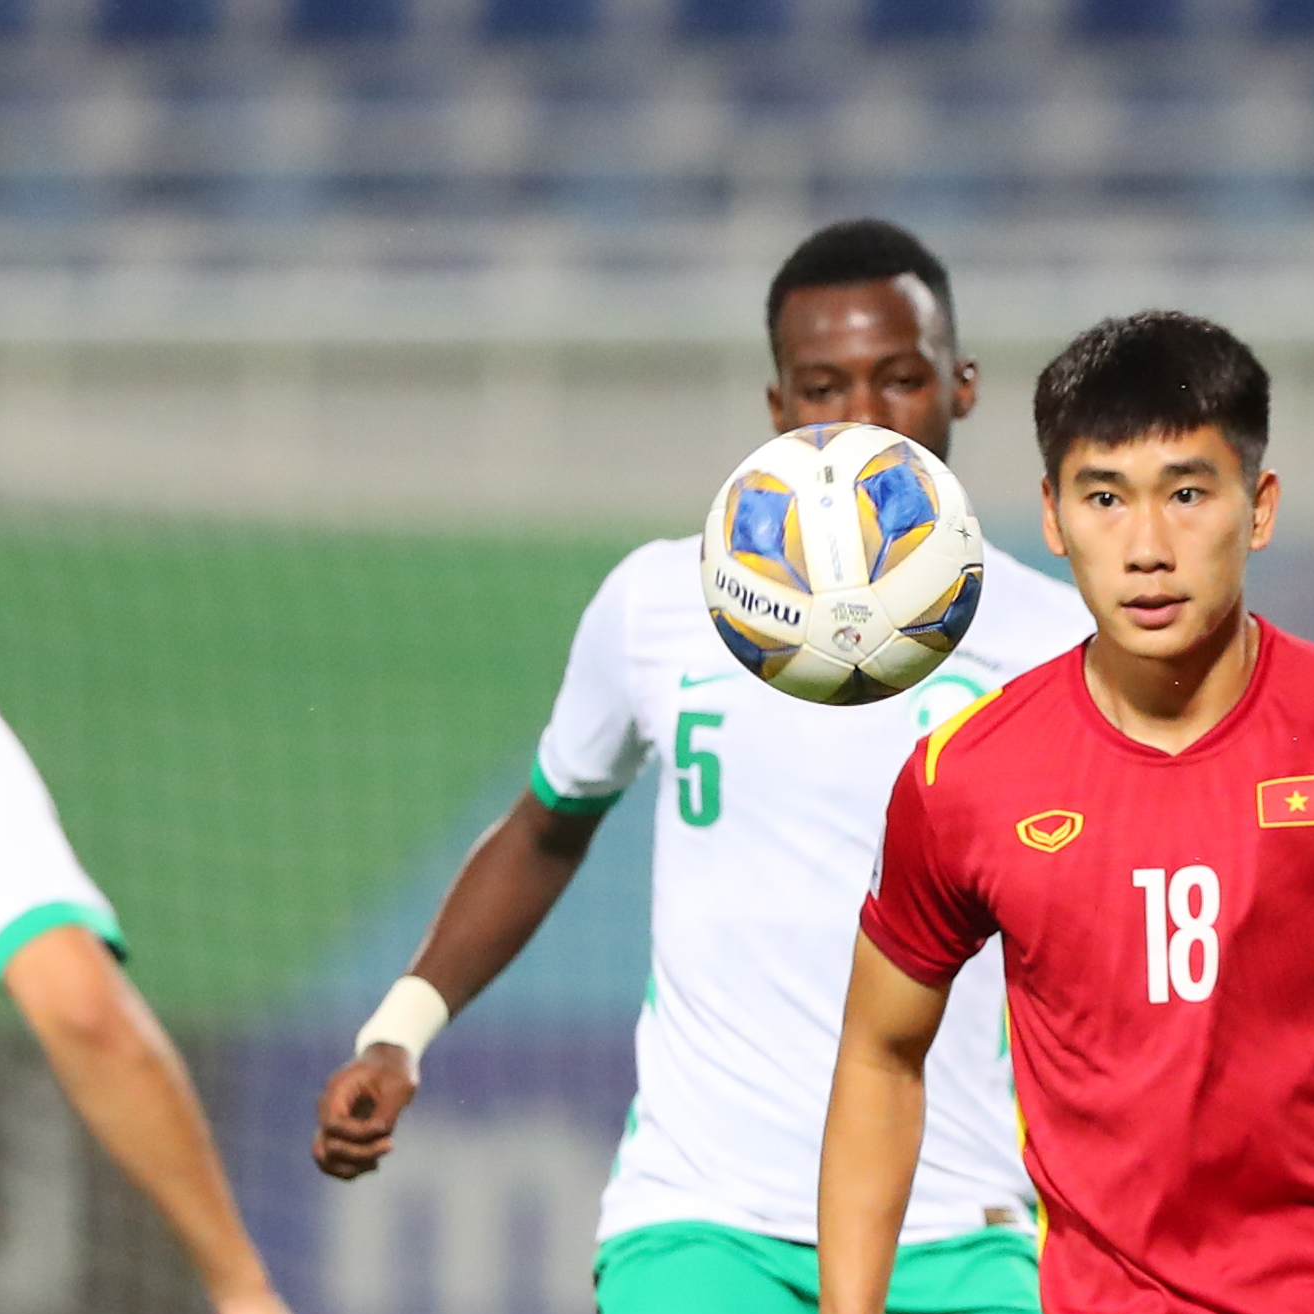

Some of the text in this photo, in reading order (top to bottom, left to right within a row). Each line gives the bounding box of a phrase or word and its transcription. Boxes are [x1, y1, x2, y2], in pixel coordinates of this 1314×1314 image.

[715, 568, 801, 626] molten
[676, 711, 724, 827] 5
[1132, 864, 1221, 1004] 18
